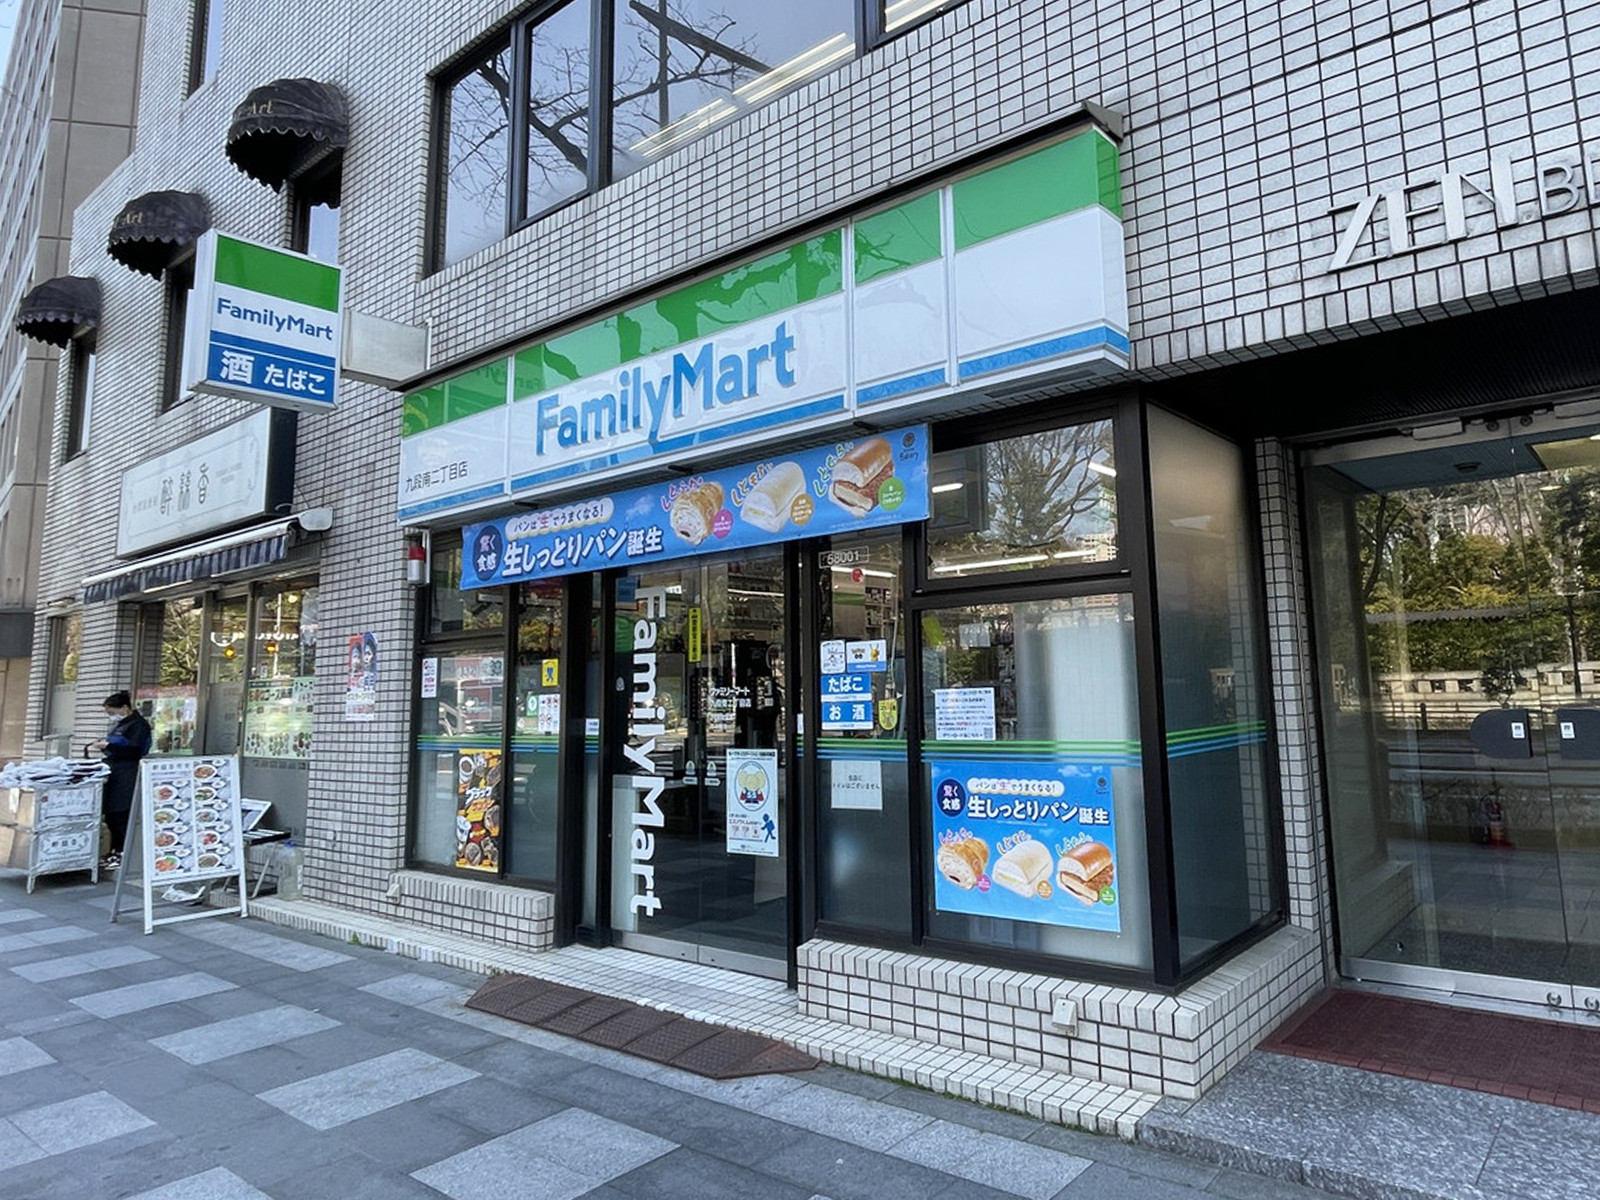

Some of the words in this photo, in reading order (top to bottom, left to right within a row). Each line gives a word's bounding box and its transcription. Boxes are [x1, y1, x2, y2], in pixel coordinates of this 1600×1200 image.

[1326, 152, 1519, 273] ZEN
[217, 297, 333, 341] FamilyMart
[219, 350, 255, 384] 酒
[263, 363, 326, 395] たばこ
[536, 321, 798, 457] FamilyMart
[828, 676, 863, 692] たばこ
[829, 705, 841, 720] お
[623, 586, 667, 917] FamilyMart
[967, 795, 1110, 825] 生しっとりパン誕生
